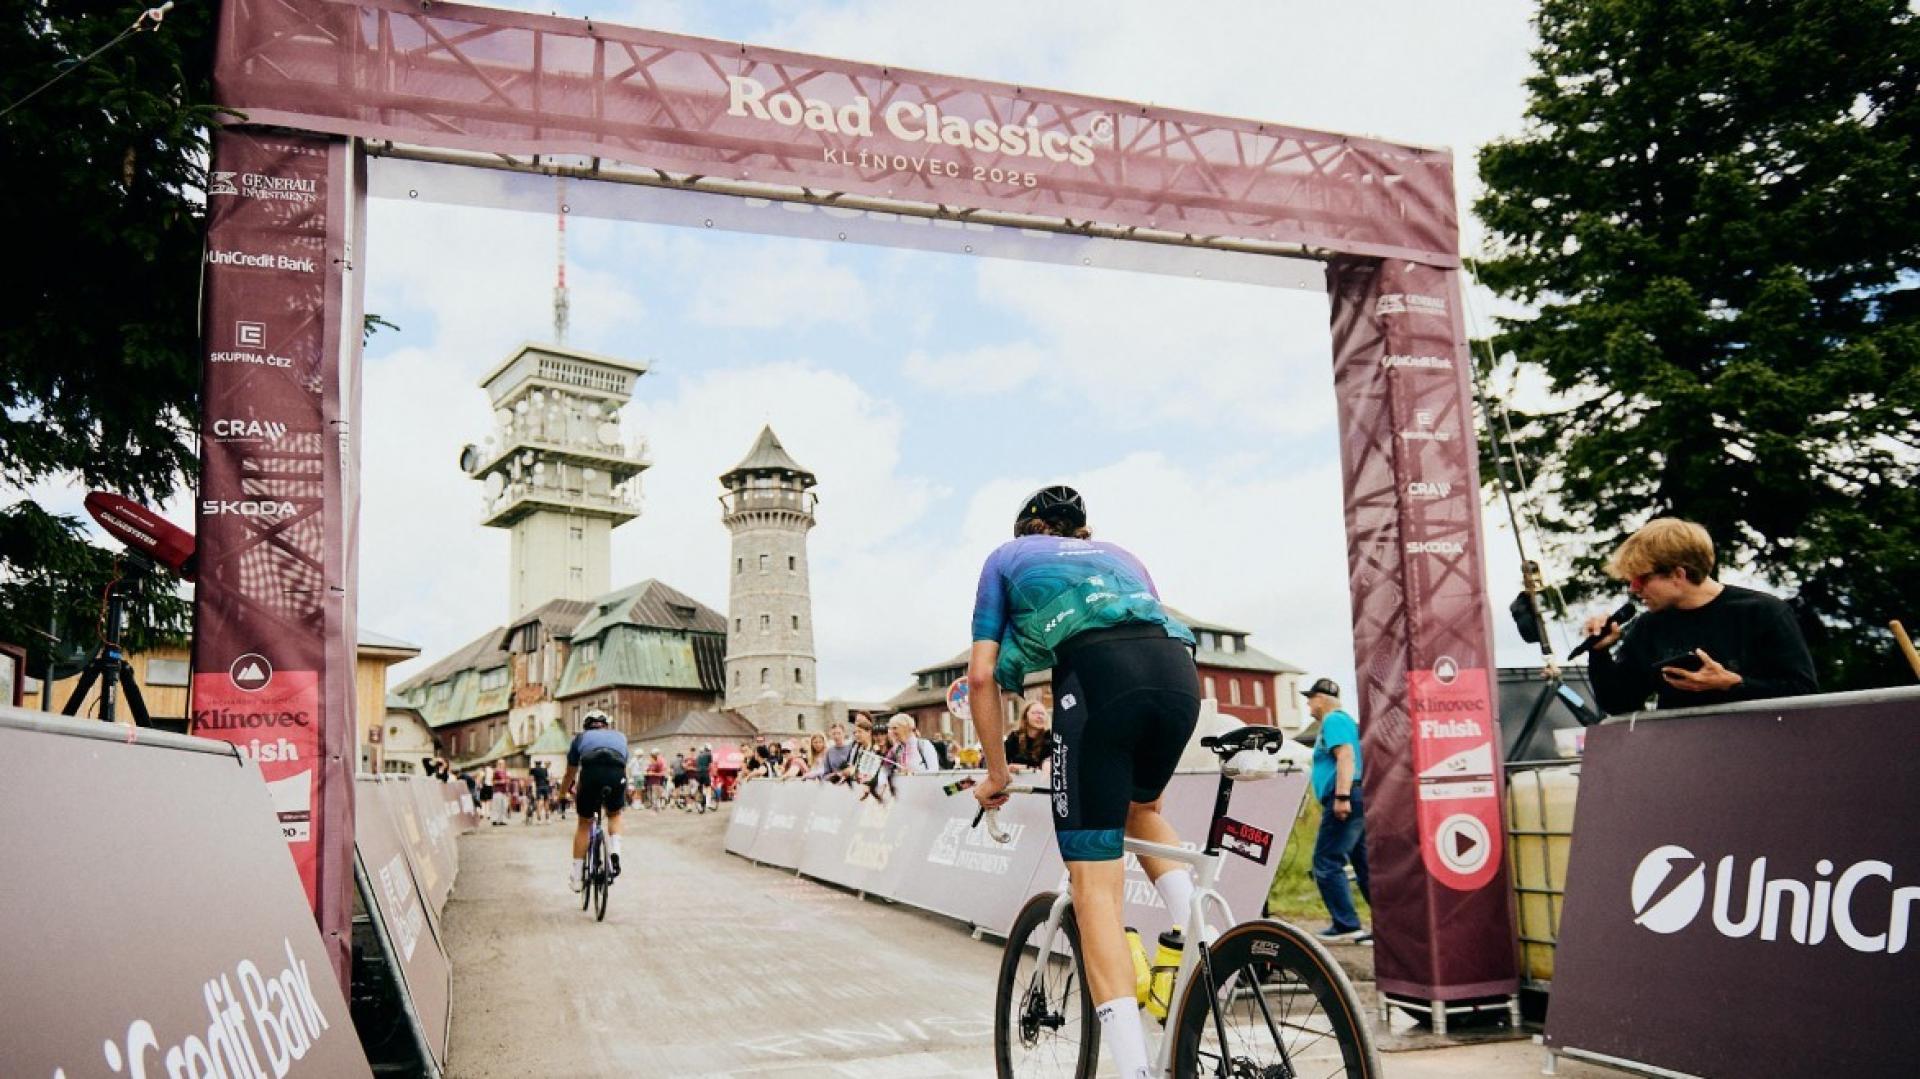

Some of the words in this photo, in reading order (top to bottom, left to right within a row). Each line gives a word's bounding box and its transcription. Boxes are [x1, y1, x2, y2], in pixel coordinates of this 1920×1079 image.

[727, 76, 873, 138] Road
[823, 147, 960, 177] KLÍNOVEC
[973, 166, 1039, 188] 2025
[242, 174, 316, 193] GENERALI
[209, 250, 276, 267] UniCredit
[277, 256, 315, 272] Bank
[210, 352, 265, 365] SKUPINA
[1414, 695, 1485, 713] Klínovec
[193, 707, 310, 731] Klínovec
[1419, 718, 1483, 740] Finish
[237, 936, 331, 1079] Bank
